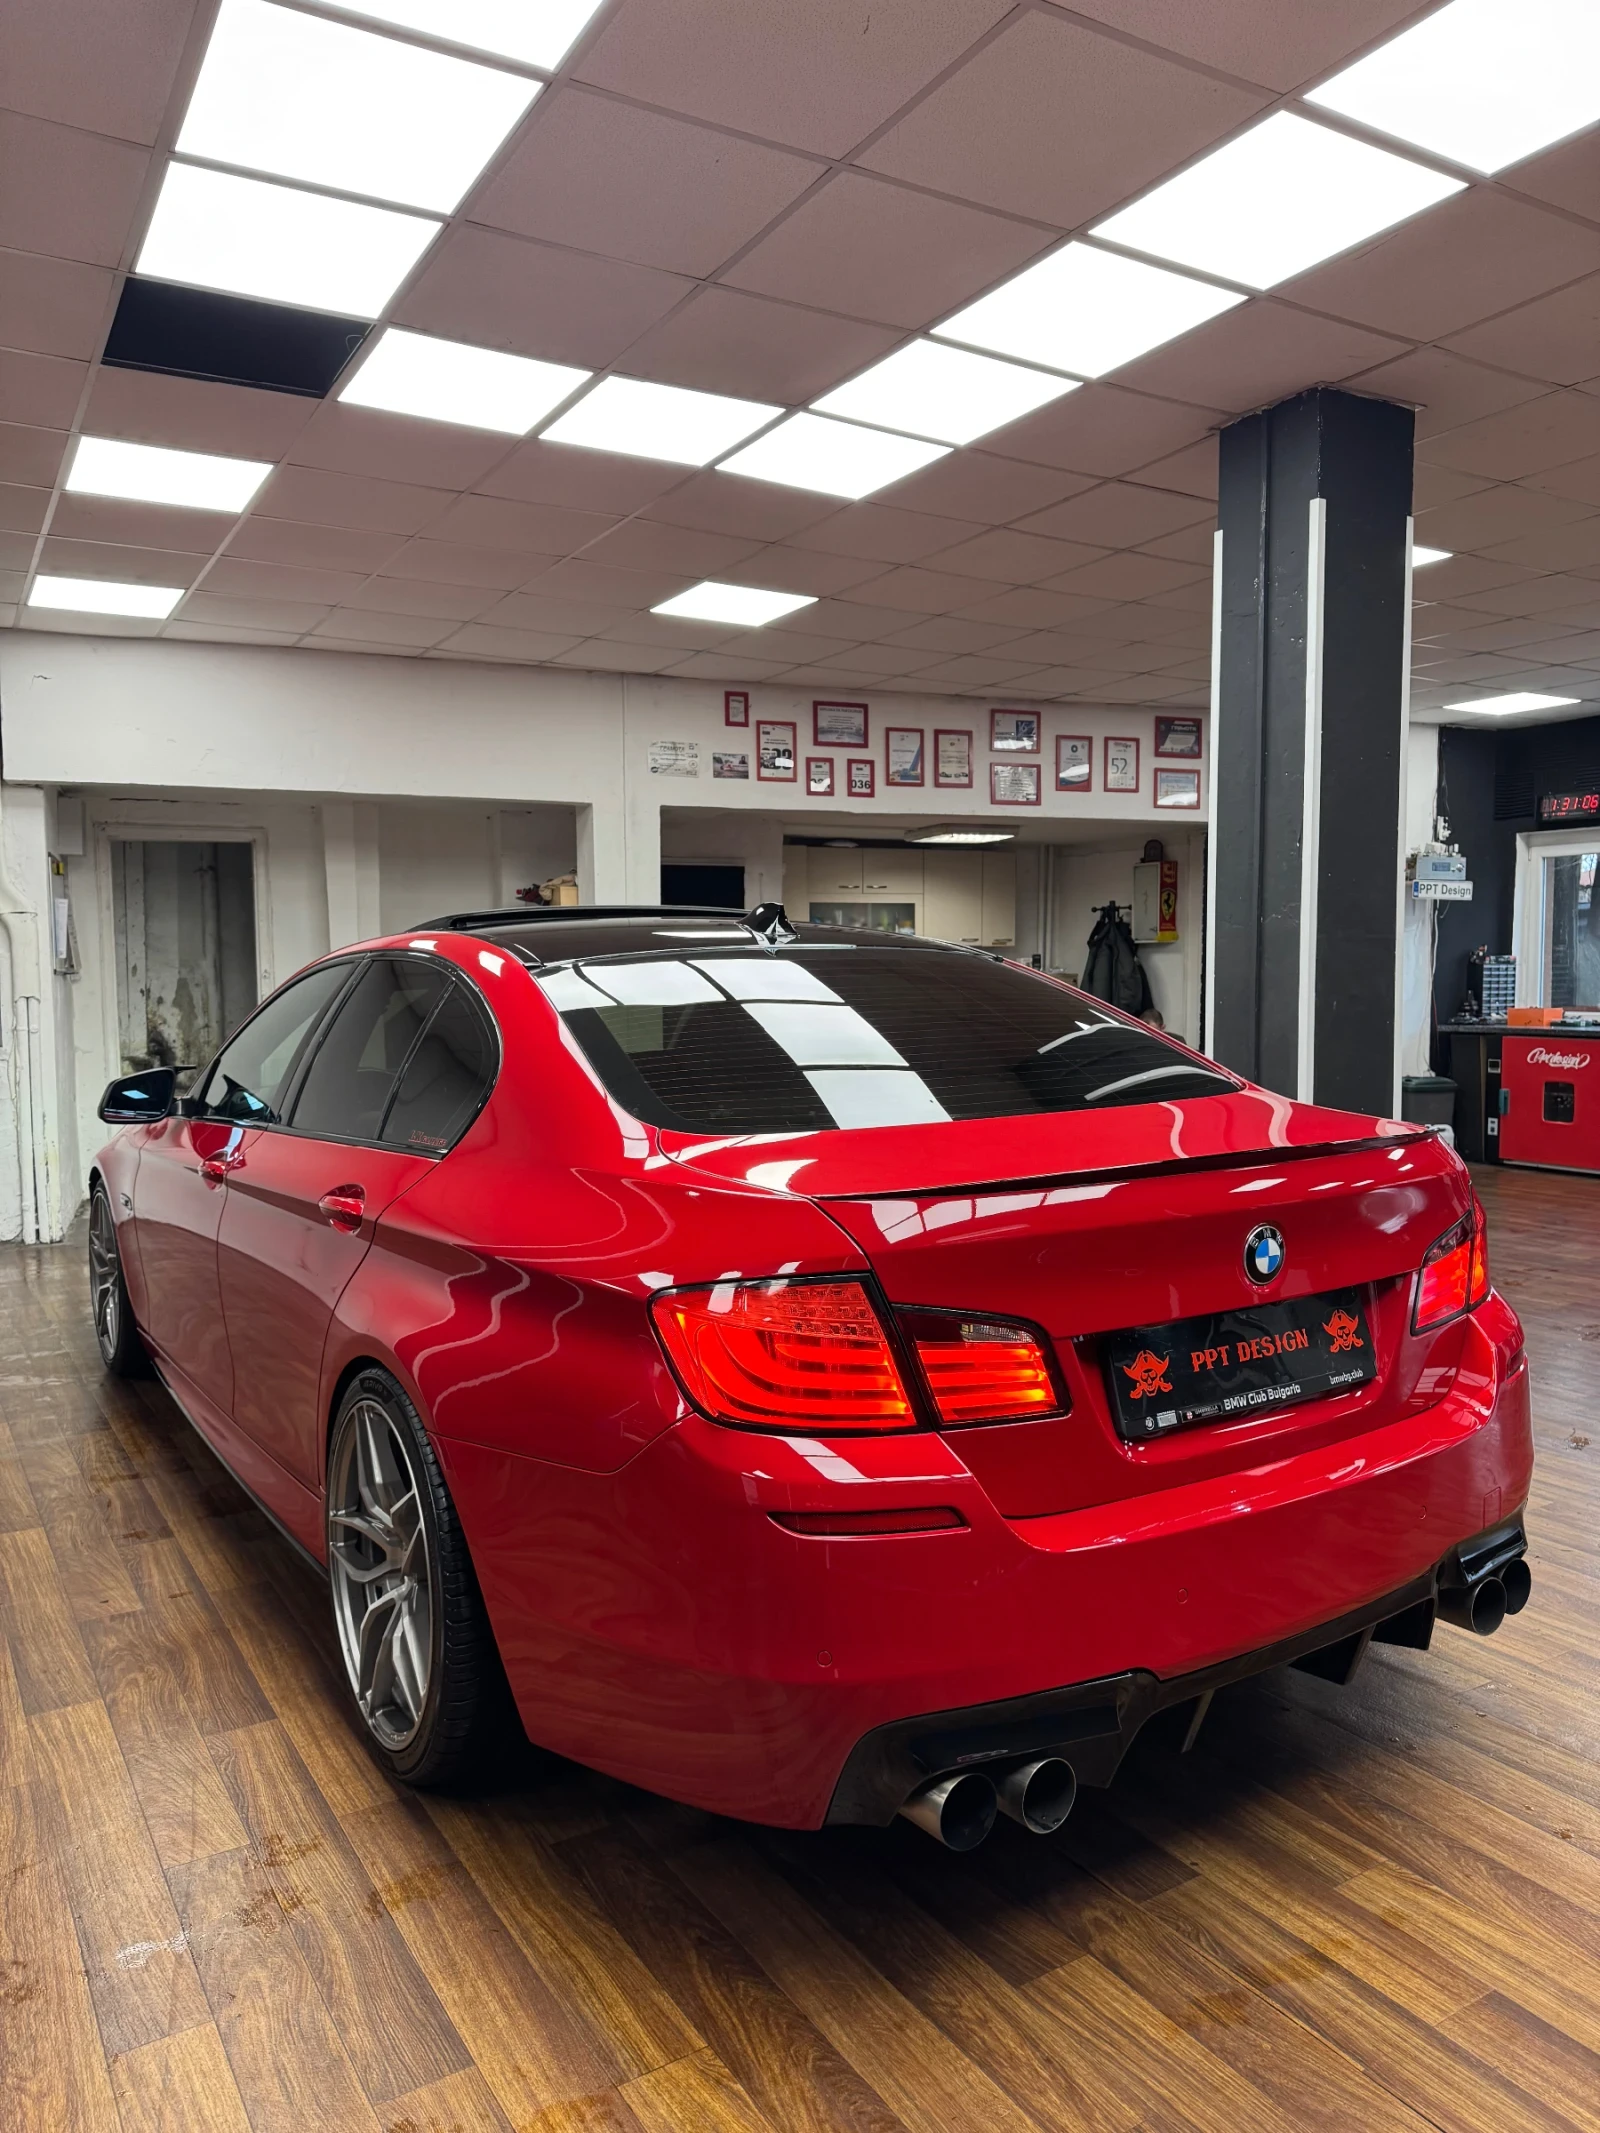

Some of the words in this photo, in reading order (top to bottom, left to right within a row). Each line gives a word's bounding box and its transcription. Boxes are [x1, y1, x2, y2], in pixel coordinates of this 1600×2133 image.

[1111, 757, 1128, 775] 52
[851, 779, 871, 790] 036
[1419, 883, 1439, 895] PPT
[1441, 884, 1471, 898] Design
[1249, 1227, 1284, 1250] BMW
[1191, 1345, 1229, 1372] PPT
[1236, 1328, 1309, 1362] DESIGN
[1224, 1396, 1247, 1411] BMW
[1248, 1390, 1268, 1405] Club
[1267, 1383, 1302, 1401] Bulgaria
